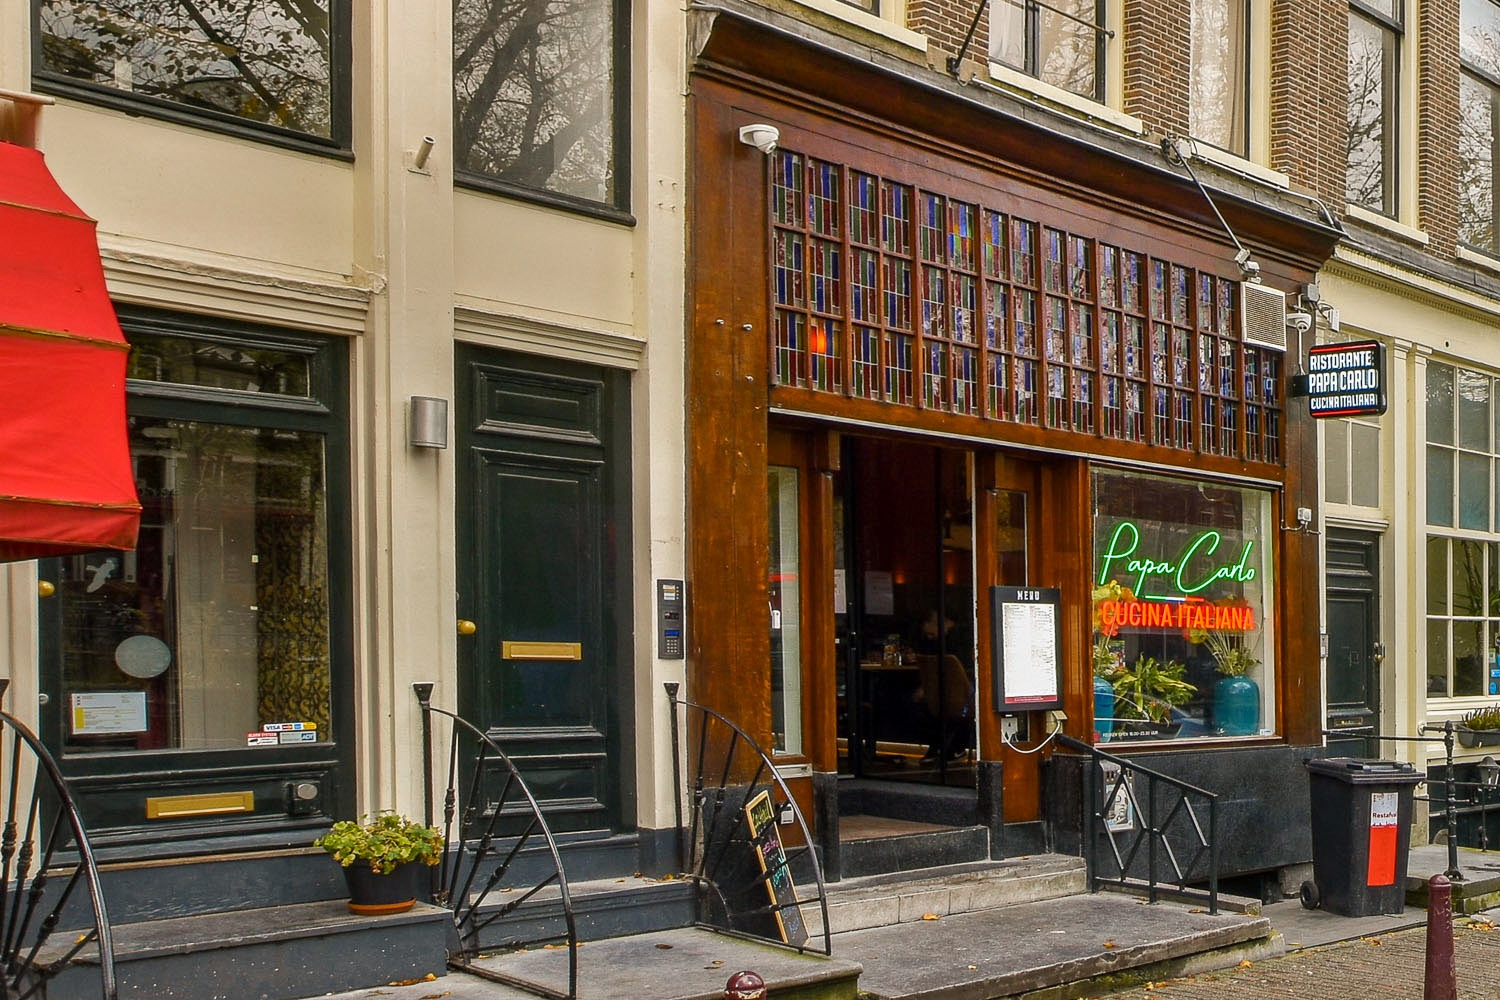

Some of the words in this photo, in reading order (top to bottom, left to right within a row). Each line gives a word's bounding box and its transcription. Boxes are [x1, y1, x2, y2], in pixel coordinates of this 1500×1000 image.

[1310, 351, 1372, 370] RISTORANTE
[1308, 371, 1338, 393] PAPA
[1340, 368, 1376, 391] CARLO
[1310, 396, 1340, 410] CUCINA
[1340, 393, 1375, 408] ITALIANA
[1100, 521, 1176, 597] Papa
[1176, 530, 1256, 594] Carlo
[1017, 590, 1040, 601] MENU
[1102, 602, 1174, 628] CUCINA
[1177, 604, 1255, 631] ITALIANA
